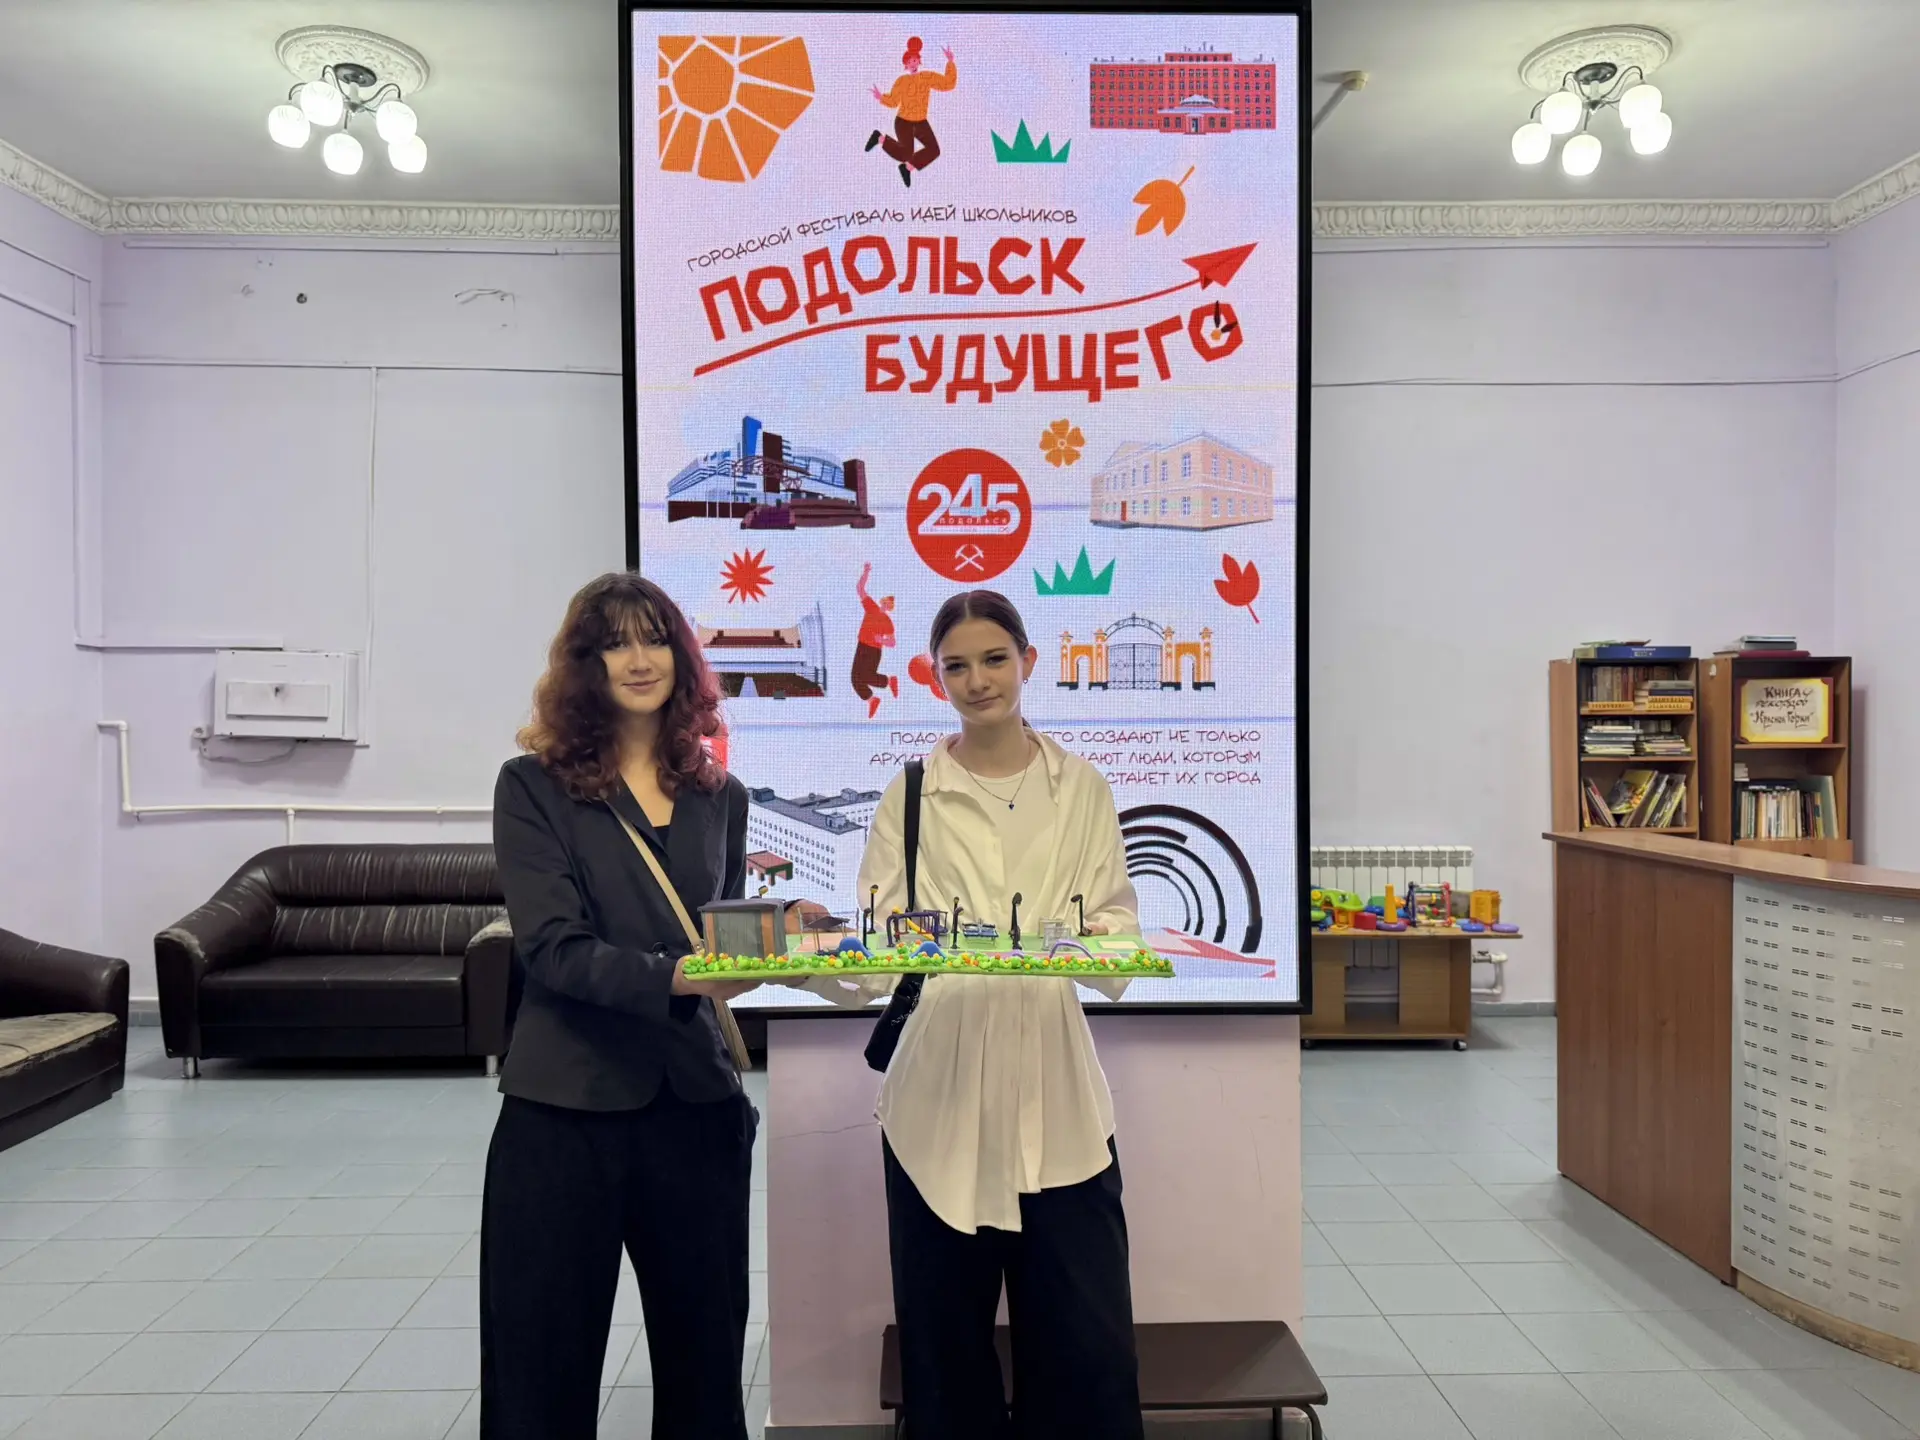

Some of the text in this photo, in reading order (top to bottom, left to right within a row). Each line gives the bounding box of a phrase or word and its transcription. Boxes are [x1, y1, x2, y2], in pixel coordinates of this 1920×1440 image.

[687, 204, 1077, 272] ГОРОДСКОЙ ФЕСТИВАЛЬ ИДЕЙ ШКОЛЬНИКОВ
[699, 235, 1086, 341] ПОДОЛЬСК
[865, 301, 1243, 403] БУДУЩЕГО
[917, 473, 1021, 535] 245
[1080, 730, 1162, 744] СОЗДАЮТ
[1169, 729, 1190, 743] НЕ
[1196, 730, 1261, 743] ТОЛЬКО
[1183, 750, 1261, 764] КОТОРЫМ
[1105, 770, 1261, 785] СТАНЕТ ИХ ГОРОД
